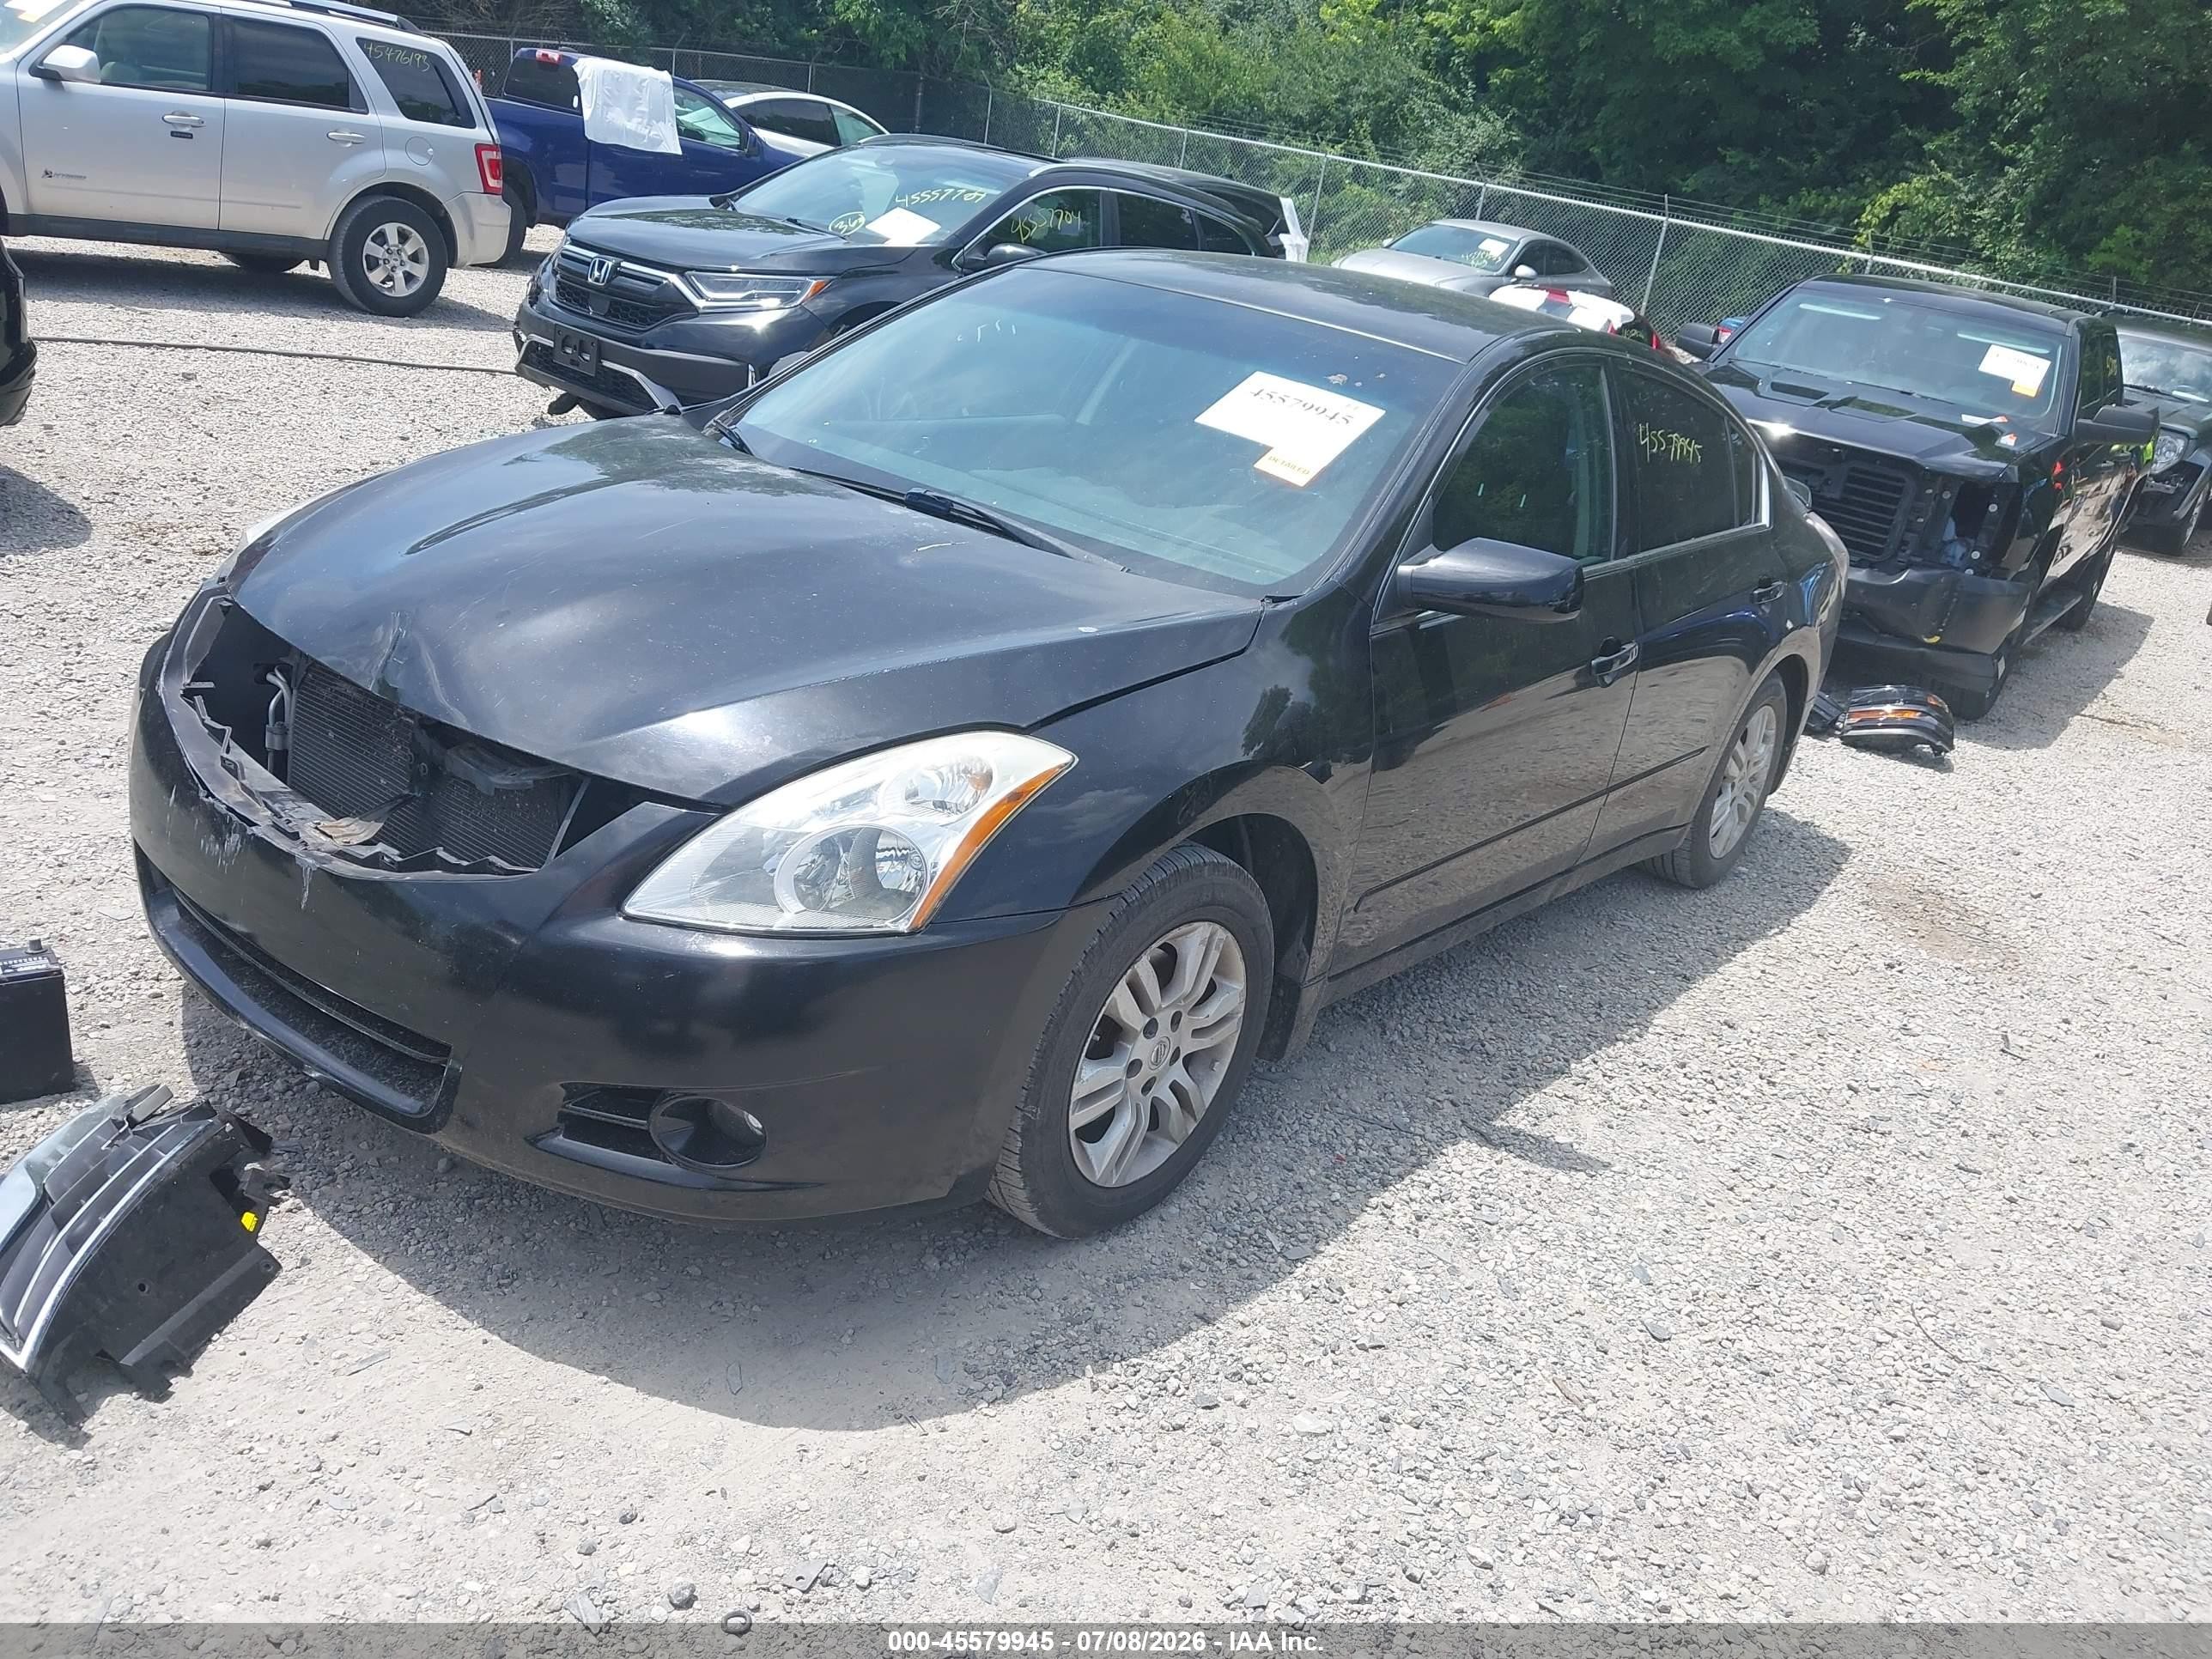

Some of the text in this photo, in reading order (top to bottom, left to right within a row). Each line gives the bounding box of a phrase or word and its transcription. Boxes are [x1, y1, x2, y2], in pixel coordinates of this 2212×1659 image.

[363, 42, 430, 72] 45476193
[1011, 208, 1081, 244] 45557704
[1250, 388, 1354, 426] 45579945
[1267, 455, 1311, 476] DETAILED
